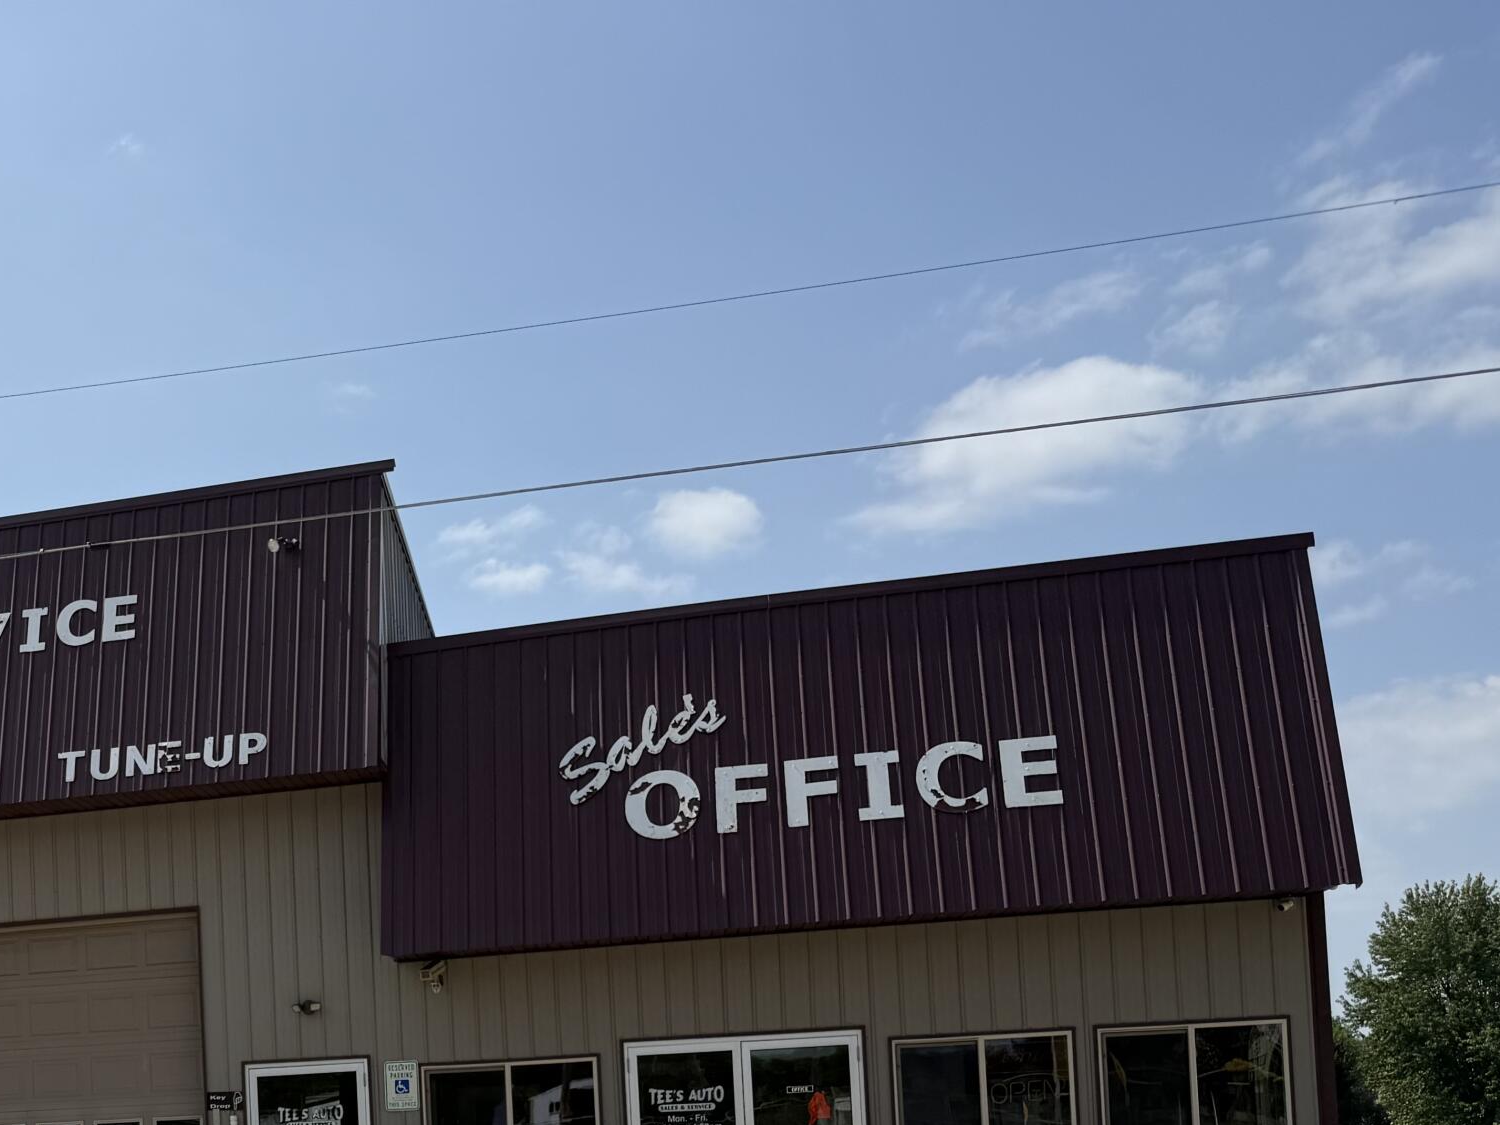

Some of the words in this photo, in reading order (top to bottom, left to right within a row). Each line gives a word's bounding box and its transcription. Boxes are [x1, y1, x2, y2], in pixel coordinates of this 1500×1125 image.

[57, 732, 268, 784] TUNE-UP
[624, 735, 1064, 840] OFFICE
[312, 1104, 344, 1120] AUTO
[648, 1088, 685, 1105] TEE'S
[688, 1085, 725, 1103] AUTO
